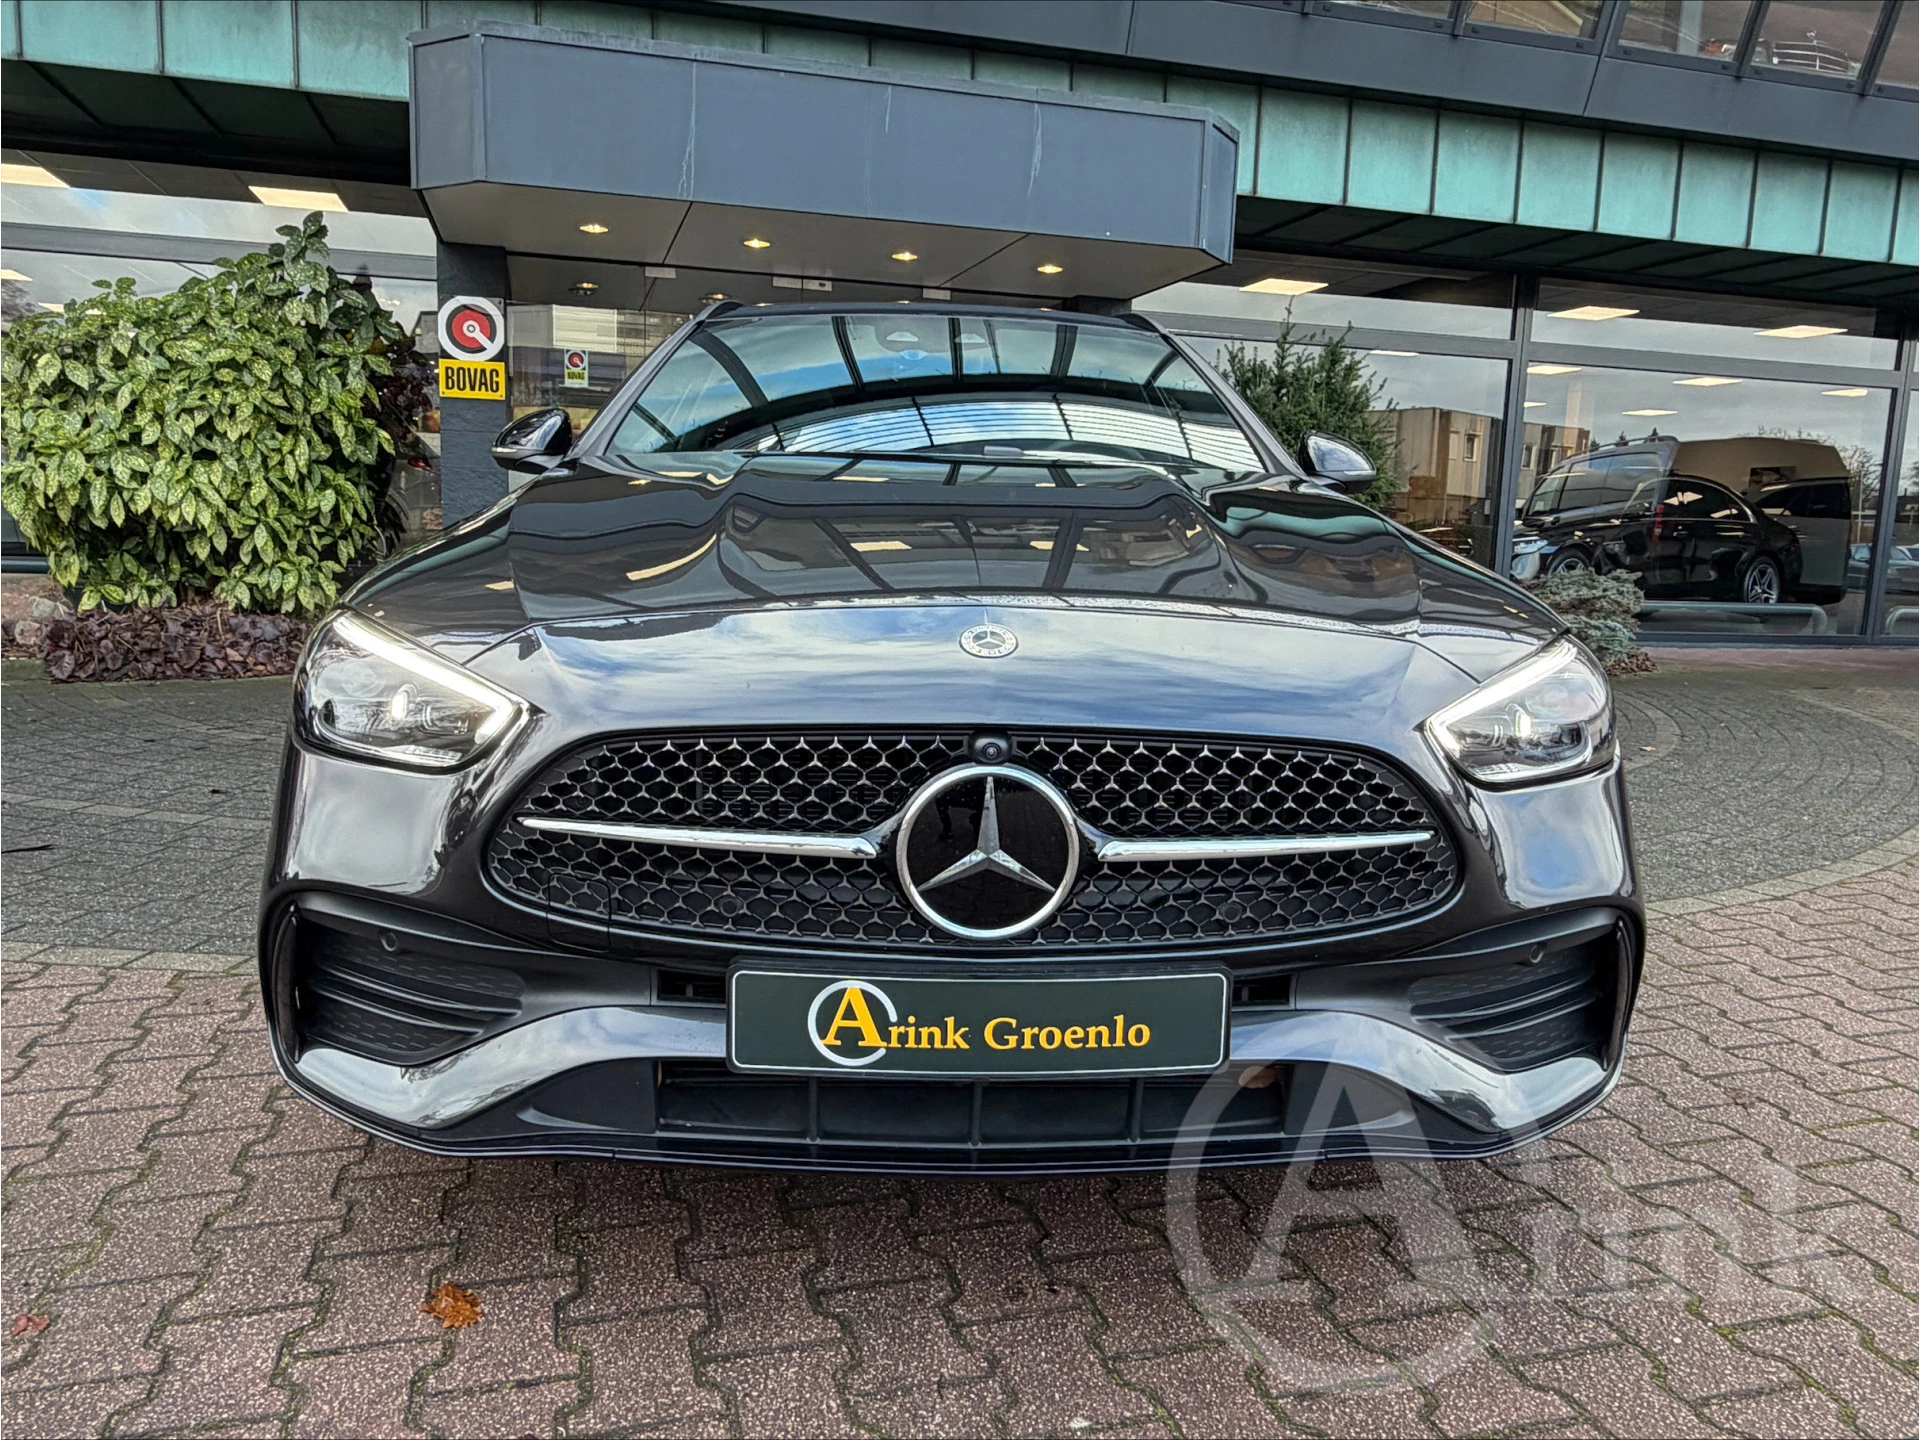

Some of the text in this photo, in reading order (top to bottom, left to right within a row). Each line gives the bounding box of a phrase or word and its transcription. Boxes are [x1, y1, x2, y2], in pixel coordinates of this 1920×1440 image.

[445, 366, 500, 393] BOVAG
[567, 371, 585, 380] BOVAG
[821, 986, 1151, 1050] Arink Groenlo
